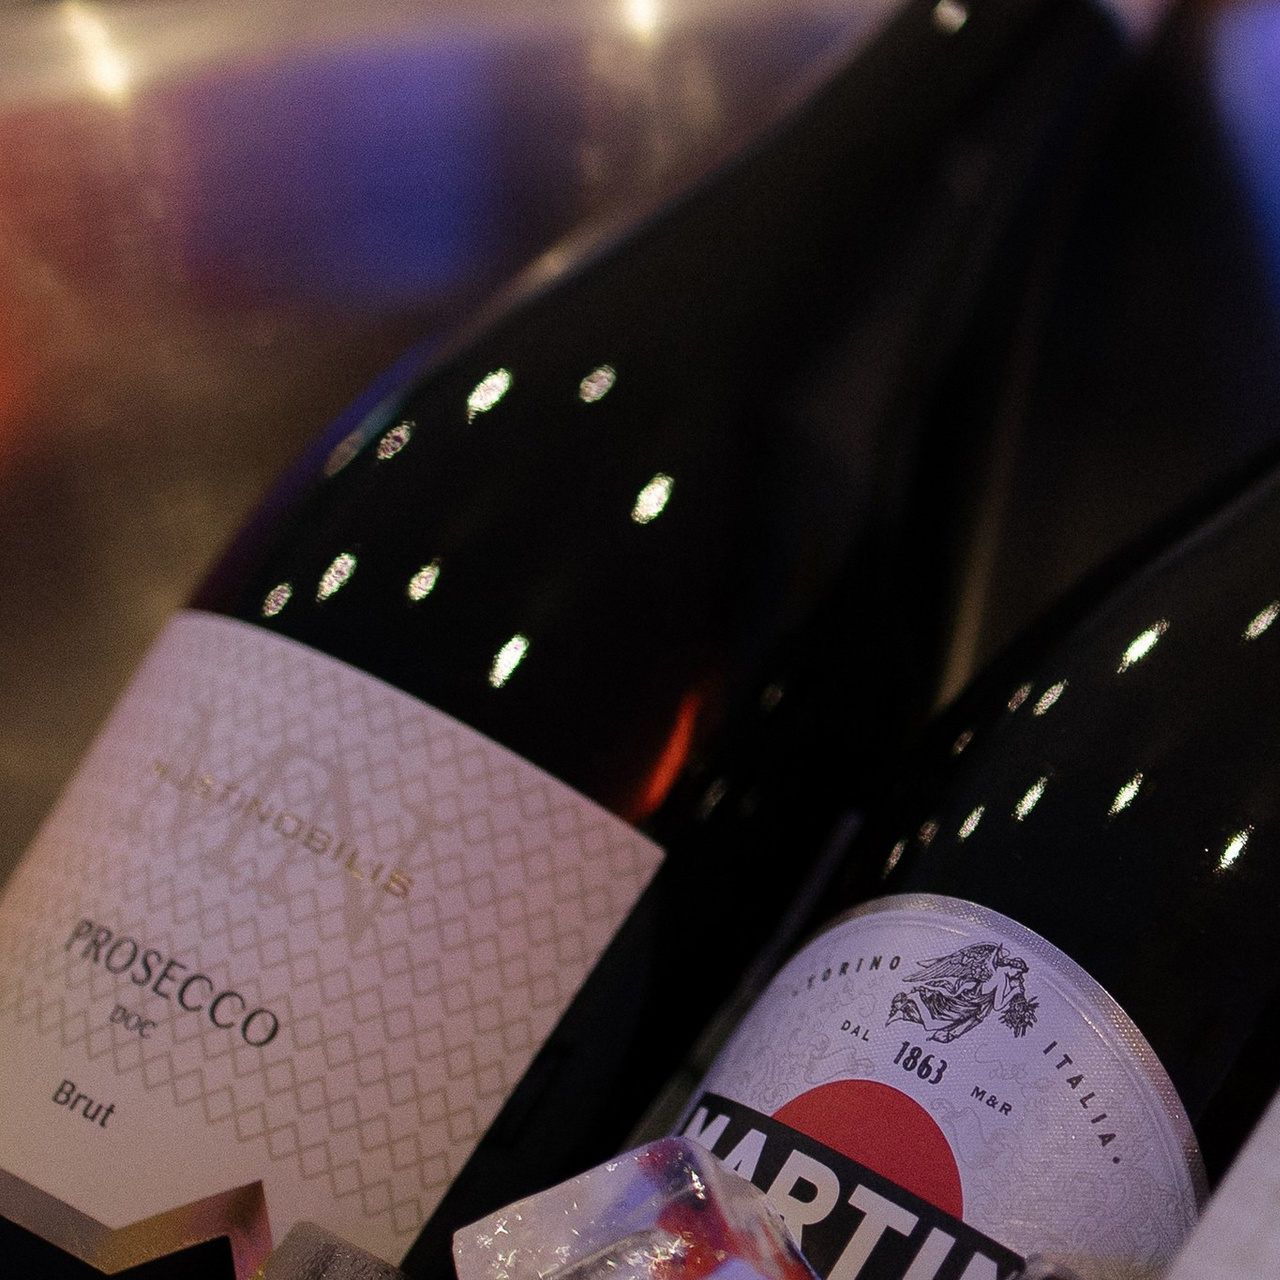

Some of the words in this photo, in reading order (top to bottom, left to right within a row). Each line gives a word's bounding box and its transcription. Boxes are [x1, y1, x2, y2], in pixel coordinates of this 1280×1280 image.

[63, 919, 280, 1048] PROSECCO
[806, 955, 900, 990] TORINO
[109, 1004, 157, 1039] DOC
[840, 1019, 870, 1042] DAL
[893, 1040, 948, 1085] 1863
[51, 1079, 116, 1128] Brut
[971, 1085, 1014, 1117] M&R
